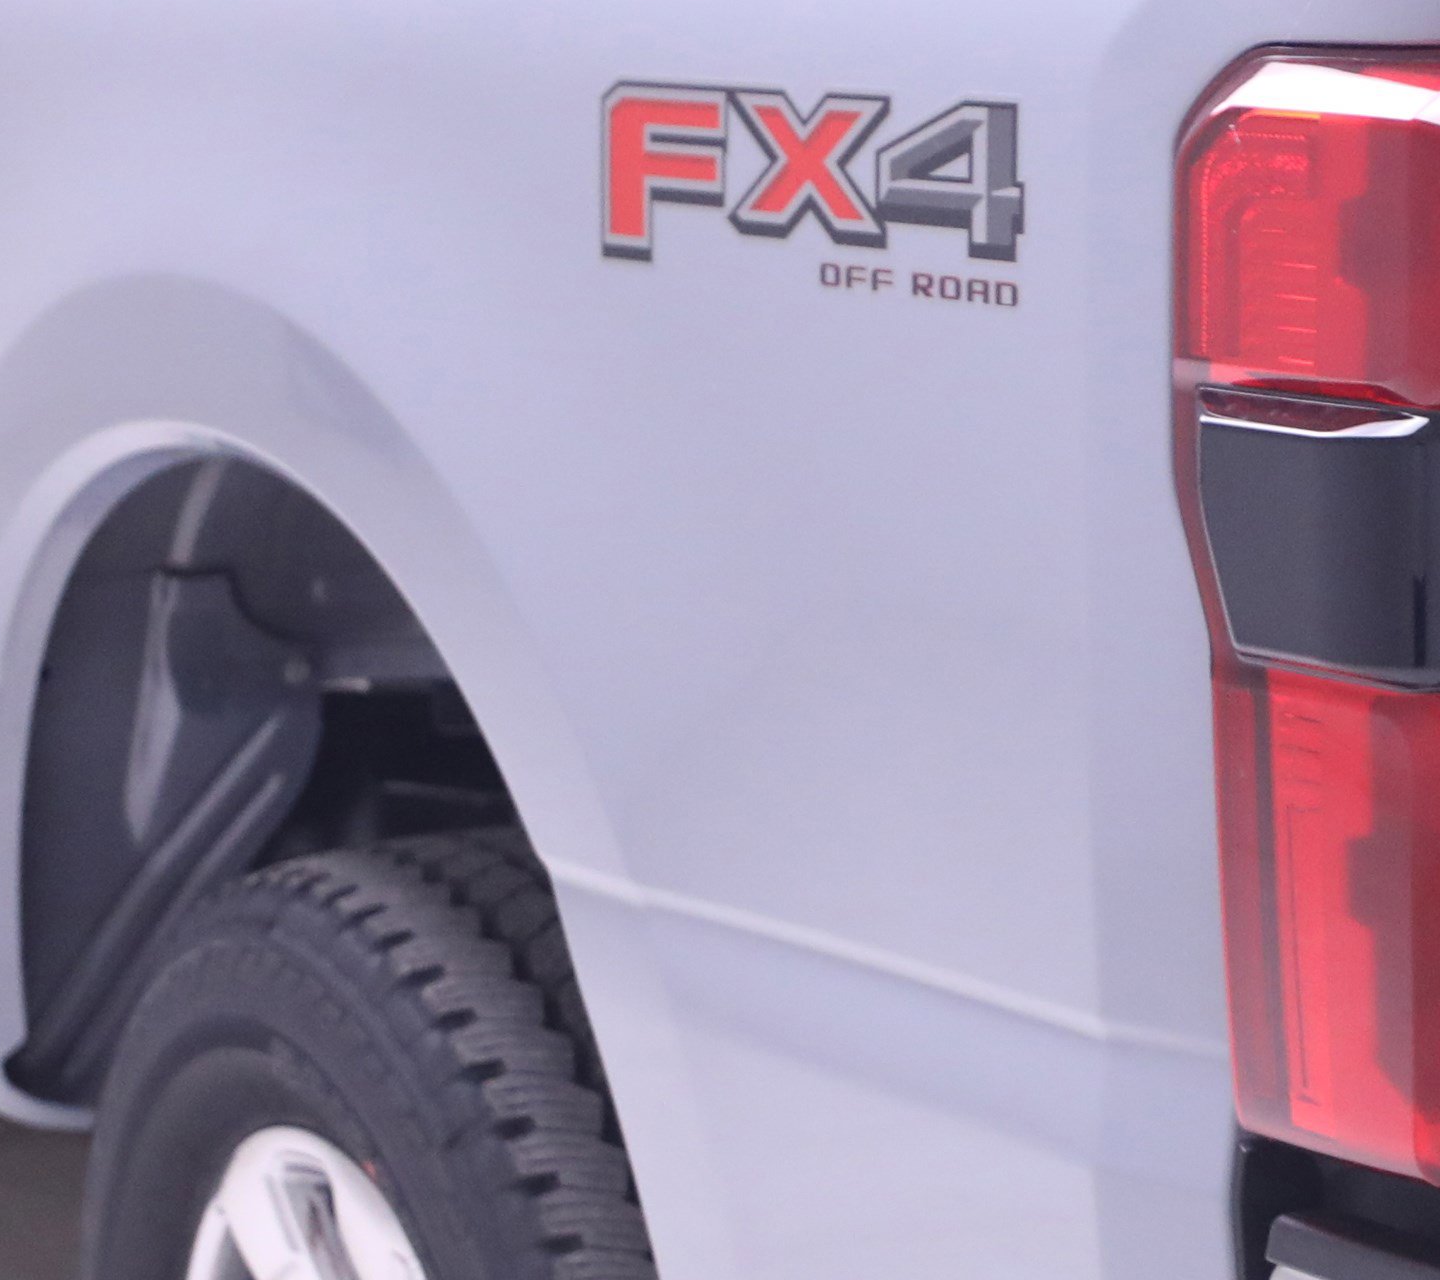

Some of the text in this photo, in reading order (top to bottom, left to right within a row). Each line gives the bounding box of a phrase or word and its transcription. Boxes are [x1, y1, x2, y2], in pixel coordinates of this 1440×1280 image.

[602, 80, 1024, 262] FX4
[819, 262, 1019, 308] OFF ROAD
